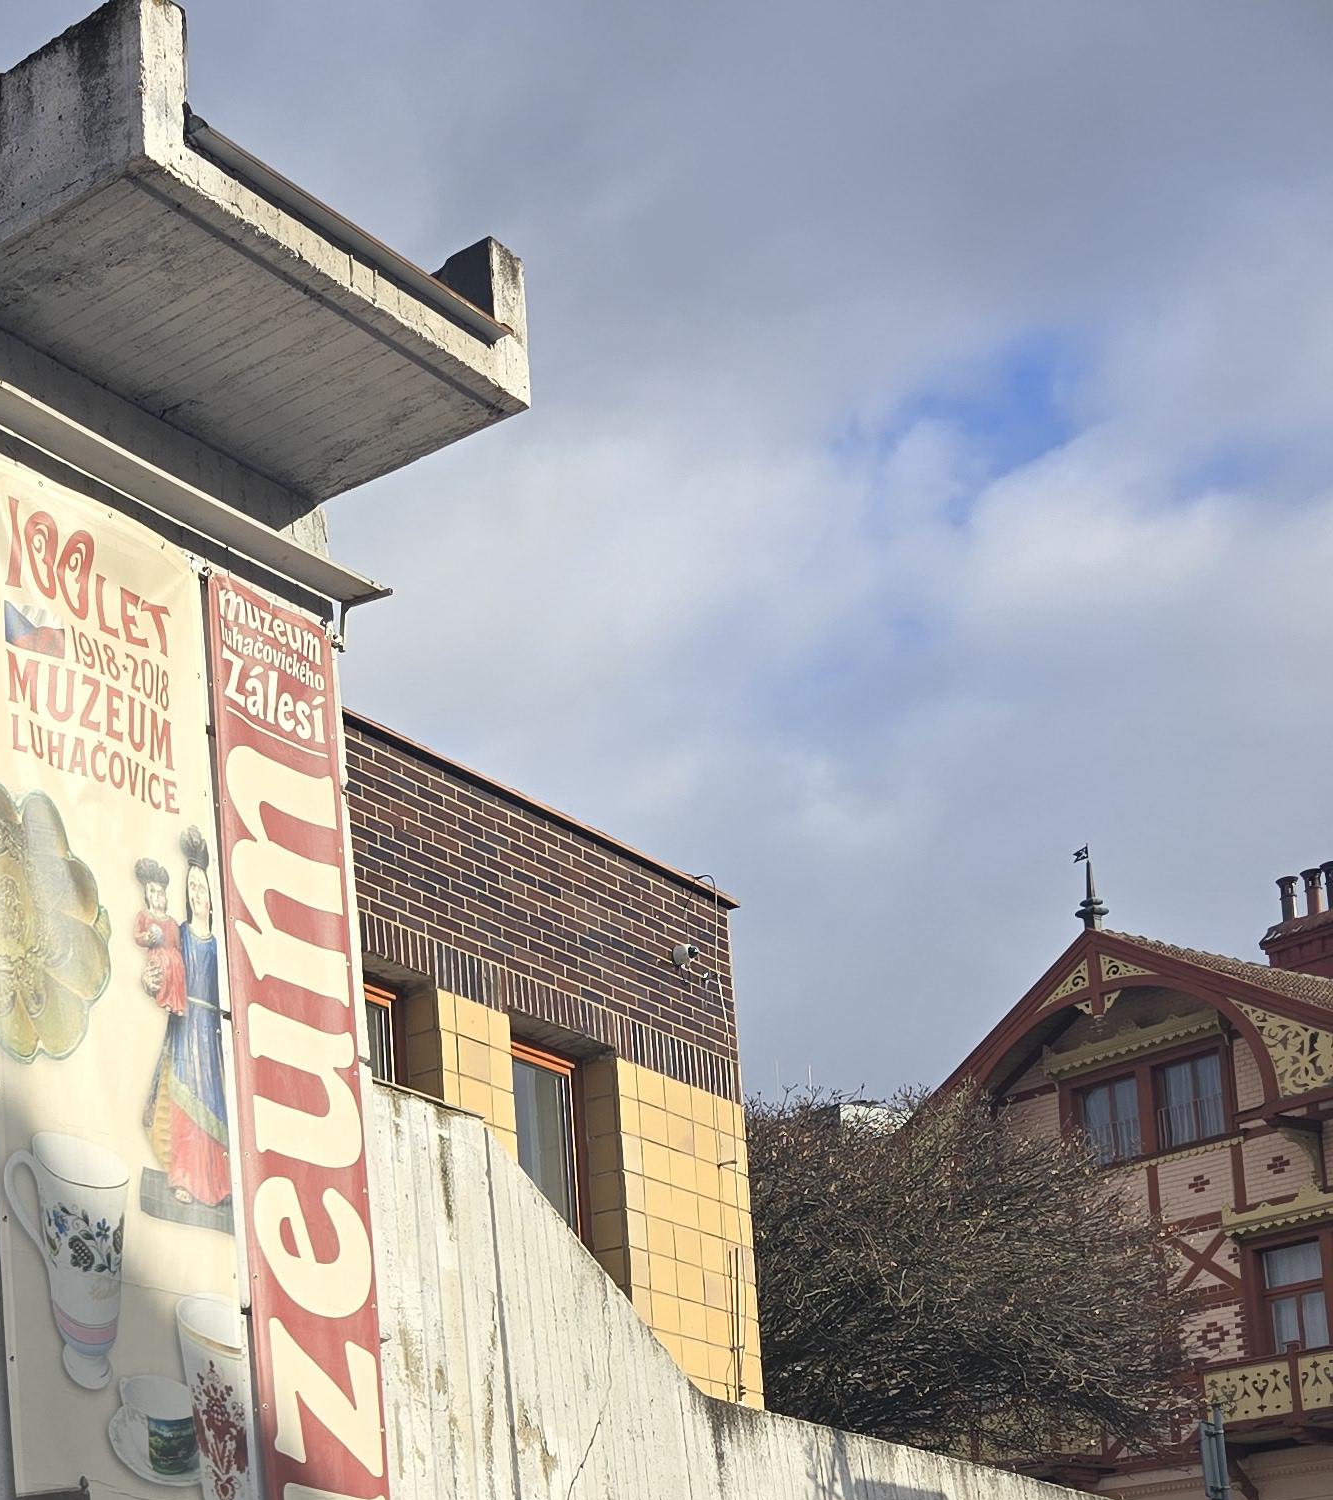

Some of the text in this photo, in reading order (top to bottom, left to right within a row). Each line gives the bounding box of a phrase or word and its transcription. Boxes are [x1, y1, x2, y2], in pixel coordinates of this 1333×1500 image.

[95, 575, 171, 658] LET
[220, 588, 323, 665] muzeum
[220, 617, 325, 692] luhačovického
[5, 649, 175, 772] MUZEUM
[222, 650, 326, 745] Zálesí
[11, 713, 180, 815] LUHAČOVICE
